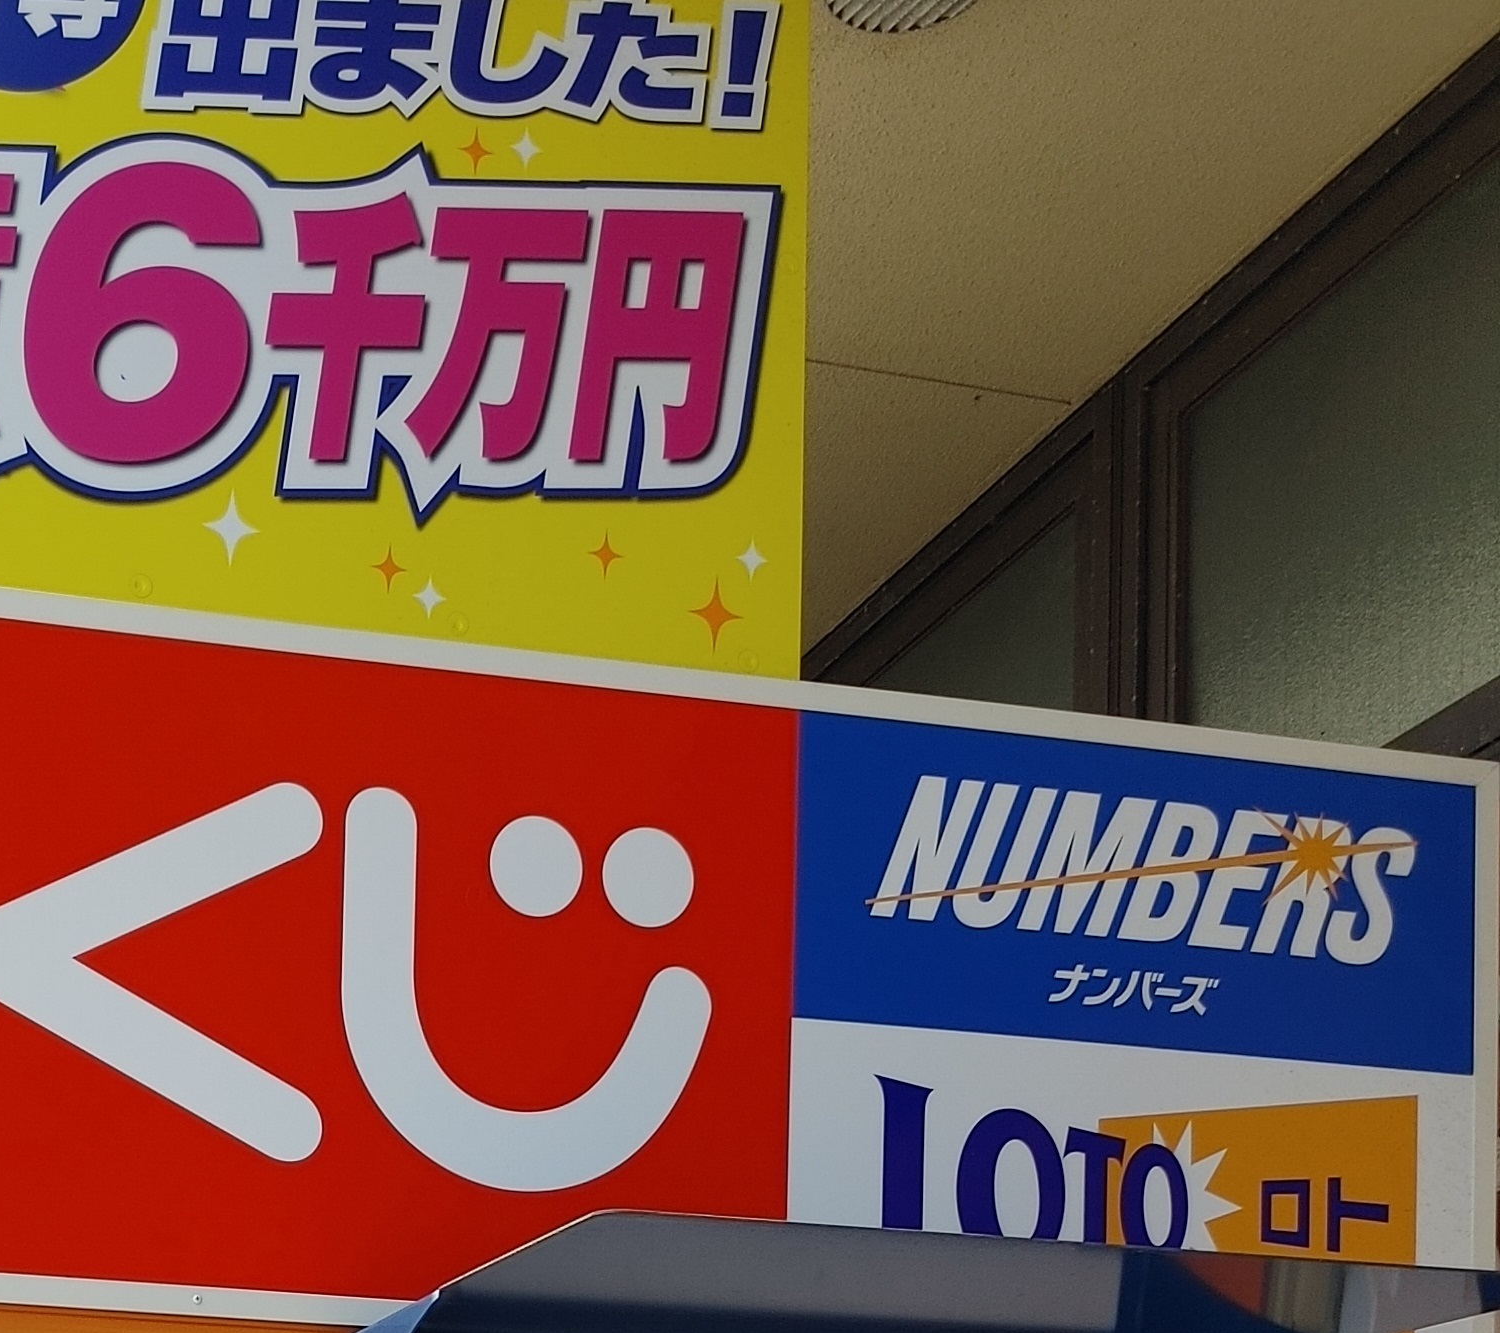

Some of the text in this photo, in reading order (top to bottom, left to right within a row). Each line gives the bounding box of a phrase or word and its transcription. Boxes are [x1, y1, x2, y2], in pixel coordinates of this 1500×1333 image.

[869, 774, 1417, 965] NUMBERS
[1048, 964, 1220, 1016] ナンバーズ
[1260, 1177, 1390, 1253] ロト
